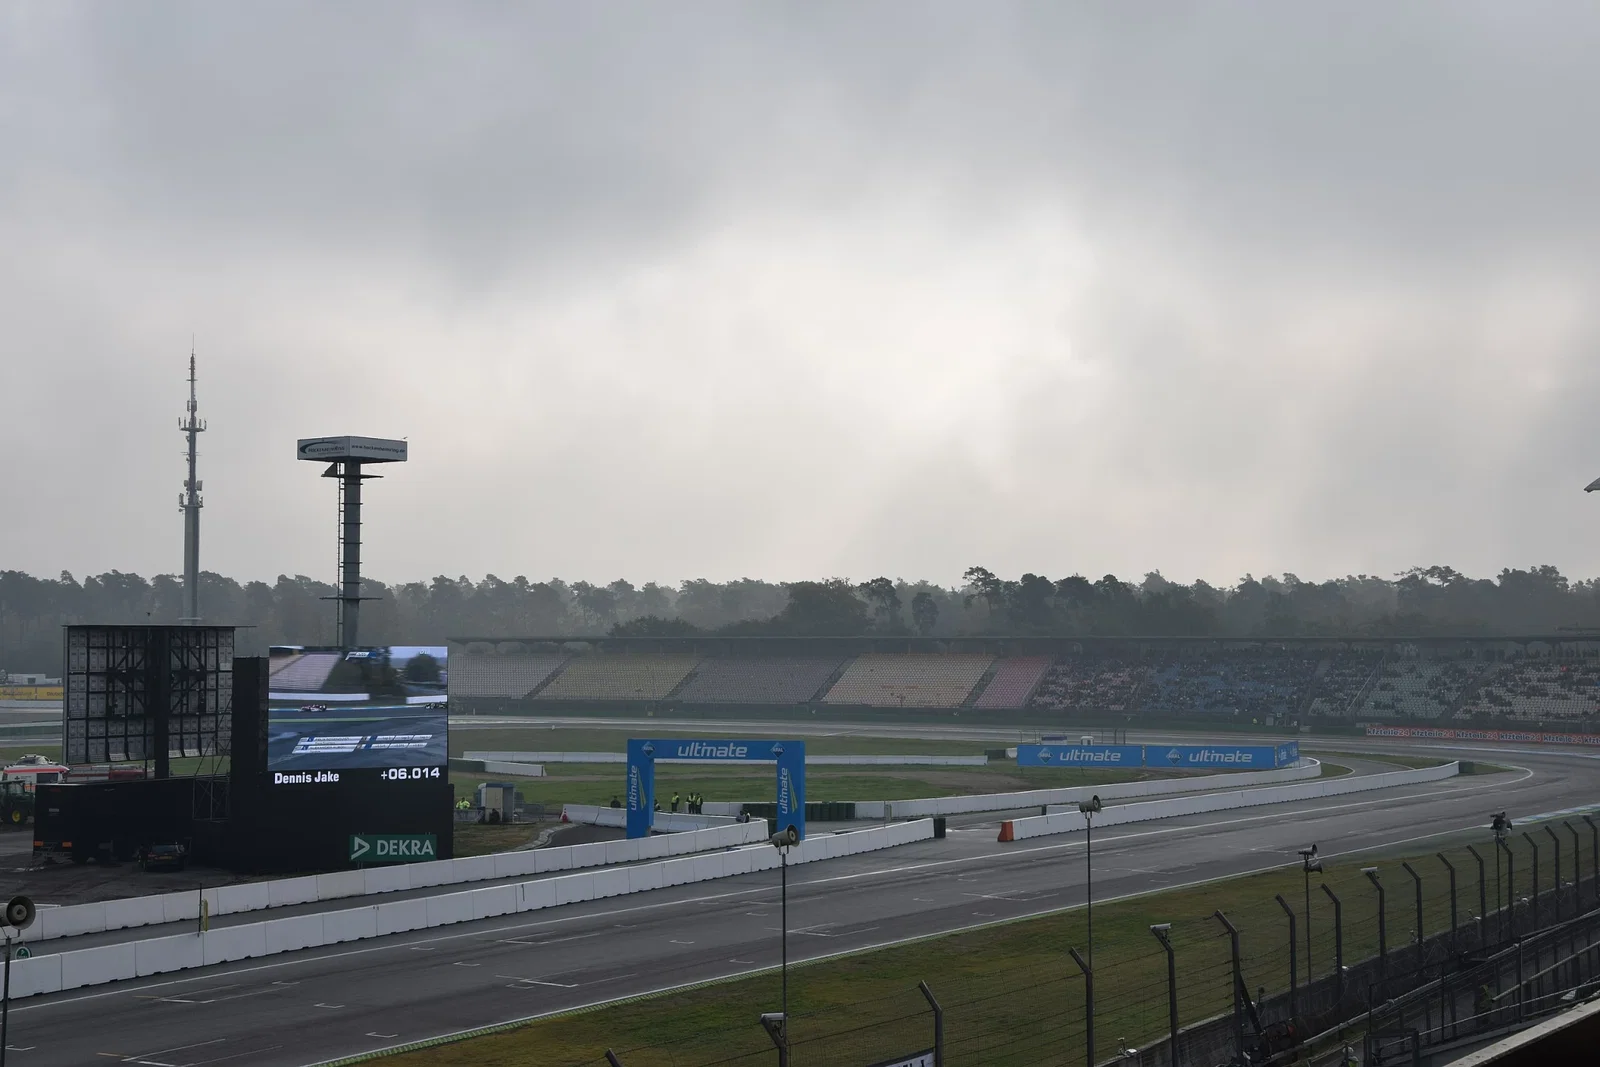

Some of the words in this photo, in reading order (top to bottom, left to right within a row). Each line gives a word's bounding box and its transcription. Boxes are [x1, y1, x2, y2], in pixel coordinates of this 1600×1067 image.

[1366, 727, 1410, 736] kfzteile24
[677, 742, 748, 757] ultimate
[1060, 749, 1121, 761] ultimate
[1189, 750, 1253, 762] ultimate
[274, 772, 312, 784] Dennis
[314, 771, 340, 783] Jake
[381, 767, 440, 780] +06.014
[629, 765, 637, 811] ultimate
[781, 767, 789, 814] ultimate
[376, 839, 434, 856] DEKRA
